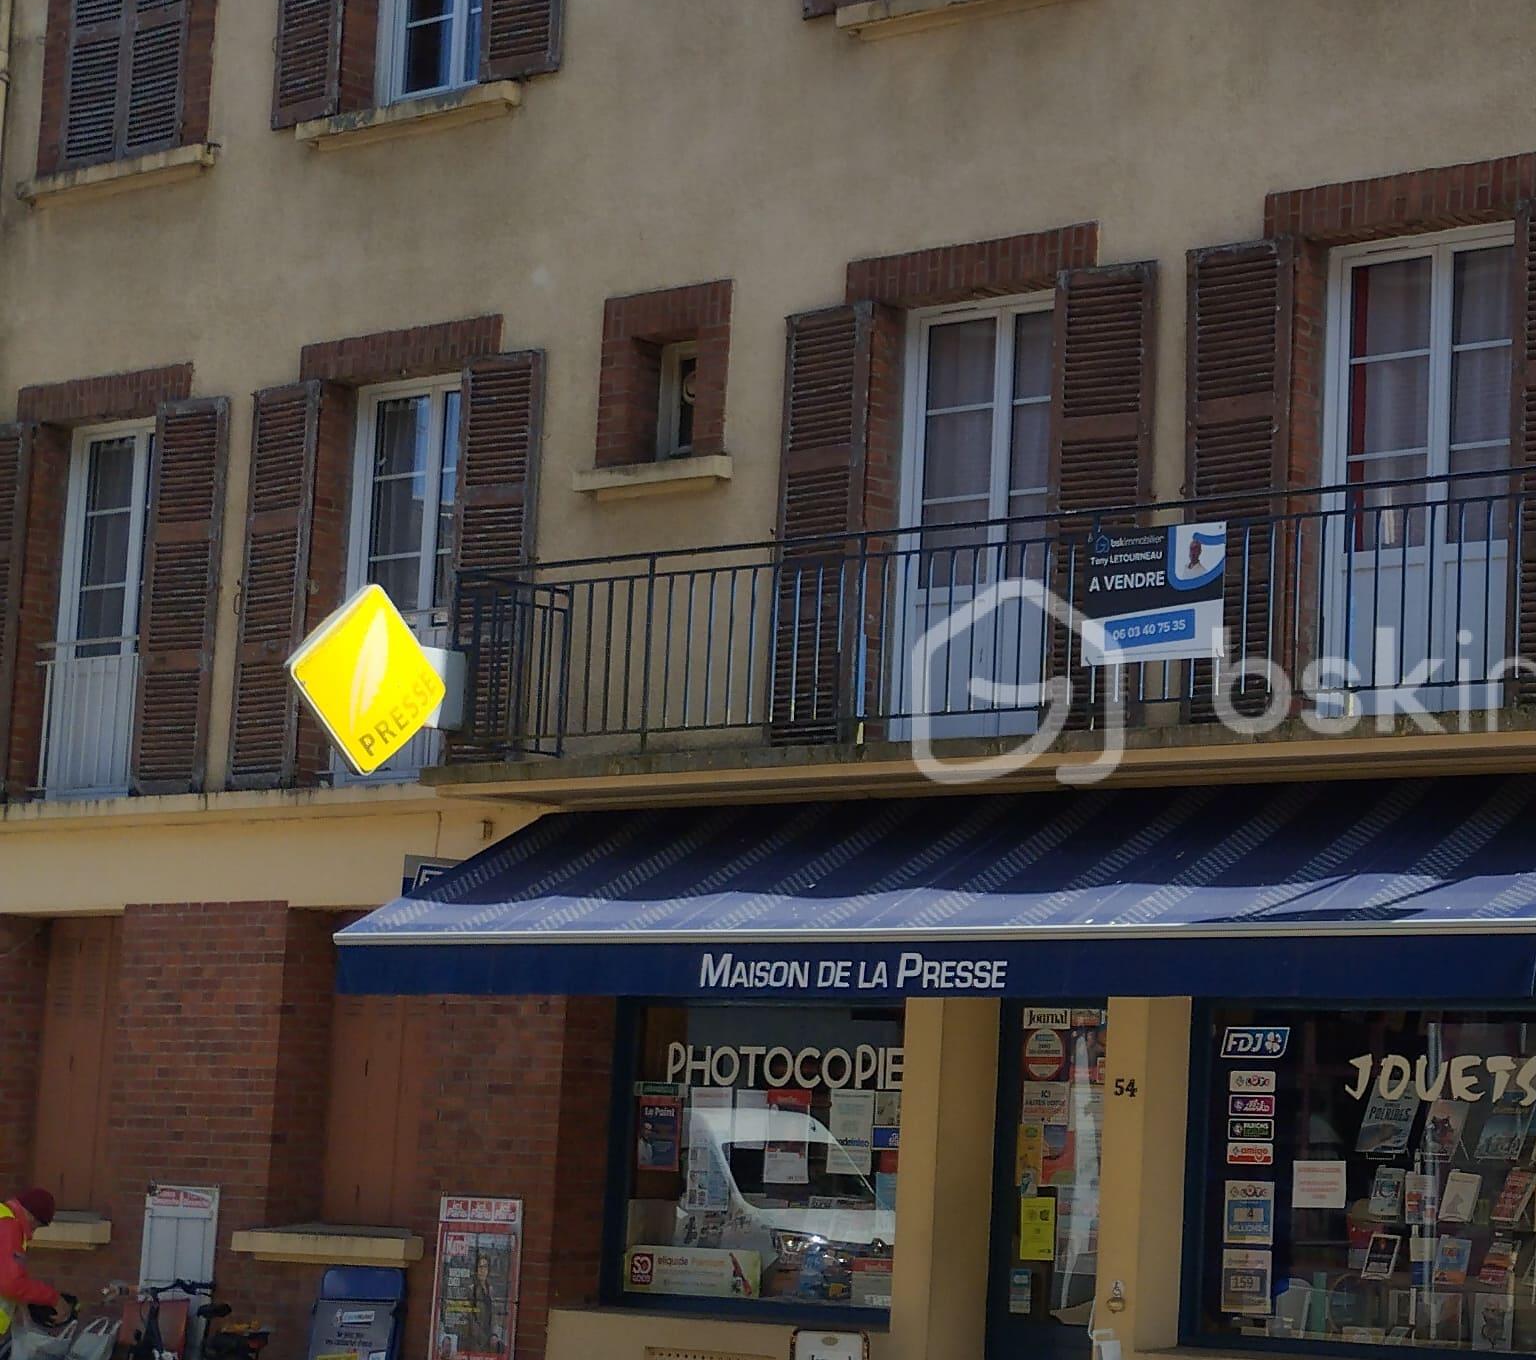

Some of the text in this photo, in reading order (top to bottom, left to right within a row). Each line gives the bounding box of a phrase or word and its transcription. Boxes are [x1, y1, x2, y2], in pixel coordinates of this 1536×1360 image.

[1089, 571, 1166, 593] A VENDRE
[1113, 630, 1126, 641] 06
[1128, 628, 1141, 638] 03
[1143, 625, 1156, 636] 40
[1158, 623, 1171, 634] 75
[358, 672, 437, 757] PRESSE
[701, 952, 1008, 988] MAISON DE LA PRESSE
[1028, 1009, 1068, 1026] Journal
[1226, 1032, 1264, 1052] FDJ
[667, 1042, 905, 1090] PHOTOCOPIE
[1113, 1078, 1138, 1097] 54
